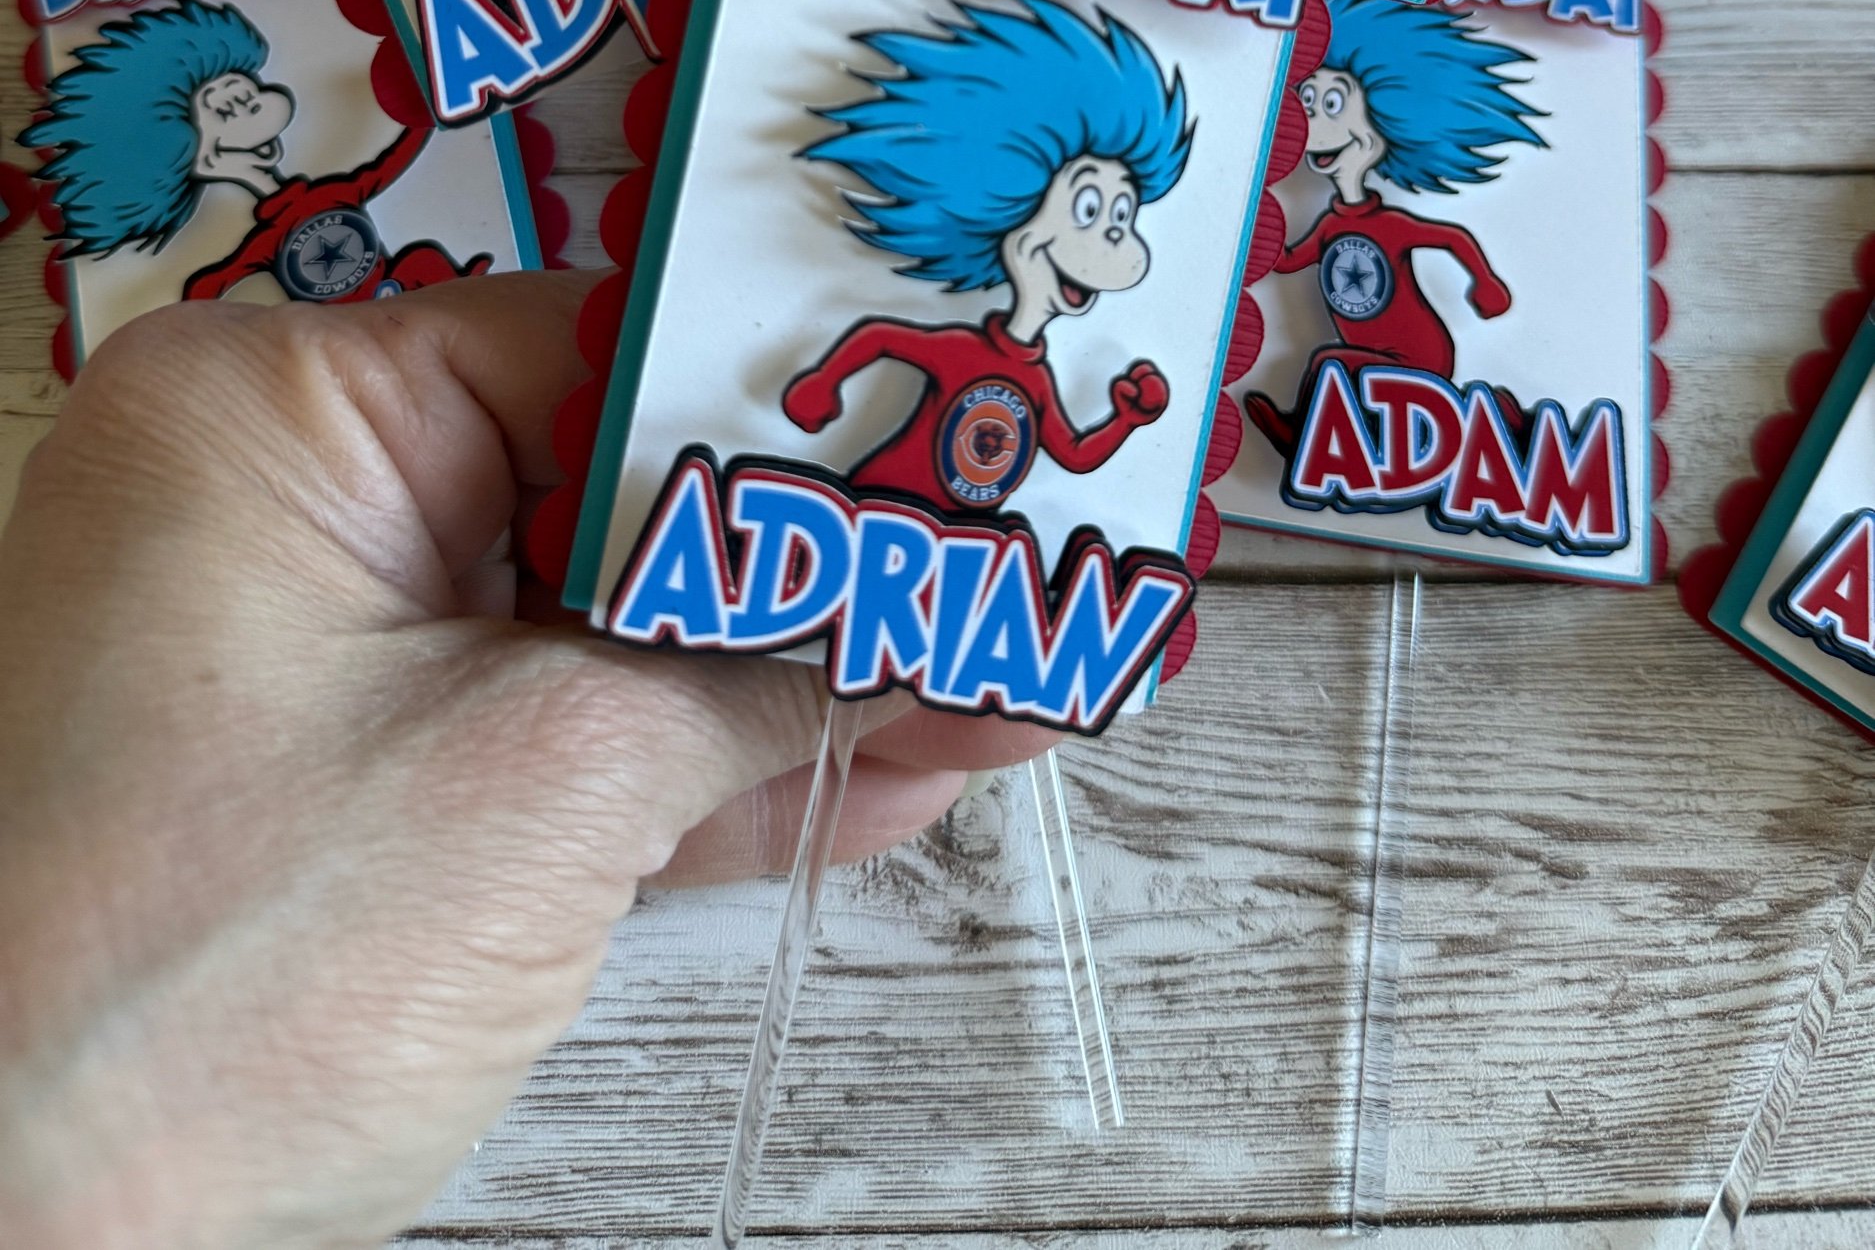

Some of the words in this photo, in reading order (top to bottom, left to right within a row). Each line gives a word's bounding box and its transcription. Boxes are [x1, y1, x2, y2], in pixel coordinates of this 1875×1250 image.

[292, 214, 344, 251] DALLAS
[1335, 241, 1376, 259] DALLAS
[314, 251, 373, 295] COWBOYS
[1330, 291, 1378, 313] COWBOYS
[963, 385, 1027, 419] CHICAGO
[1294, 366, 1621, 539] ADAM
[951, 475, 1000, 501] BEARS
[611, 461, 1192, 728] ADRIAN
